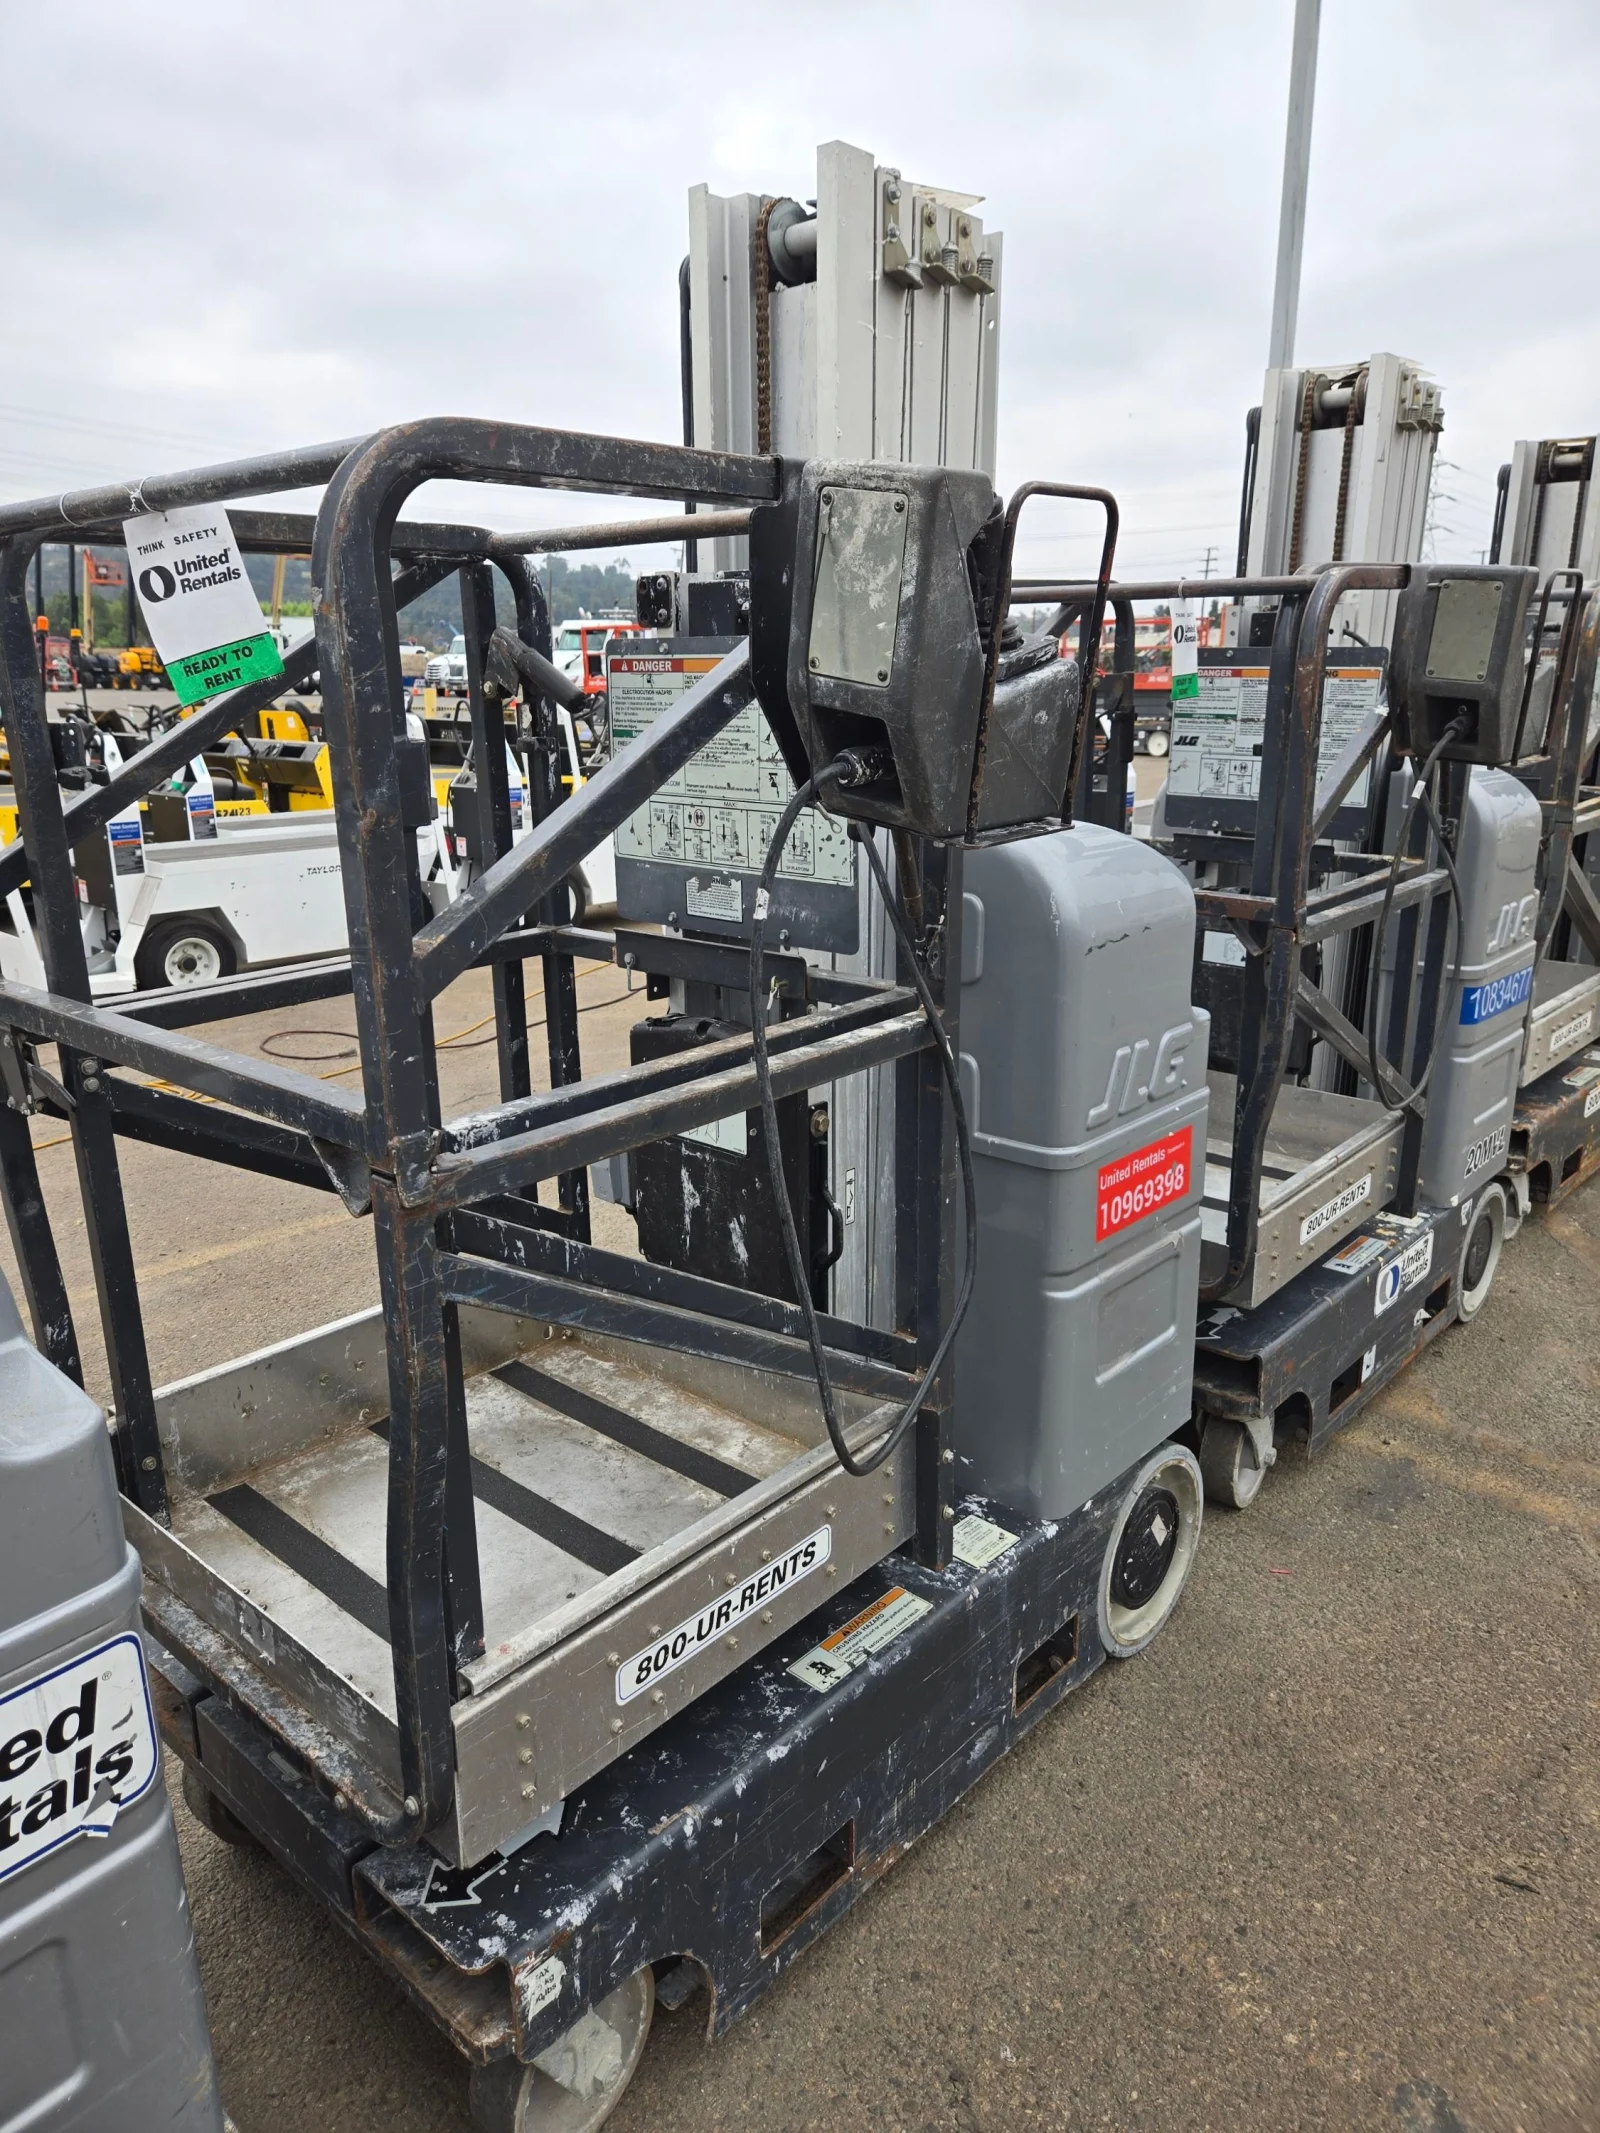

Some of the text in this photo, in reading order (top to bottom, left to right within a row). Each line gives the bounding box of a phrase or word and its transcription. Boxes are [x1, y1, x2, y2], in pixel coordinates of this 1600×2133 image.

[137, 527, 218, 556] THINK SAFETY
[173, 549, 229, 576] United
[180, 566, 241, 594] Rentals
[183, 646, 253, 678] READY TO
[632, 660, 672, 671] DANGER
[1198, 669, 1232, 677] DANGER
[203, 668, 242, 690] RENT
[1173, 735, 1200, 747] JLG
[1470, 966, 1533, 1019] 10834677
[1099, 1165, 1130, 1191] United
[1132, 1148, 1166, 1176] Rentals
[1100, 1163, 1185, 1230] 10969398
[1306, 1180, 1367, 1236] 800-UR-RENTS
[1401, 1242, 1429, 1271] United
[635, 1540, 817, 1685] 800-UR-RENTS
[845, 1601, 887, 1635] WARNING
[832, 1613, 885, 1653] CRUSHING HAZARD
